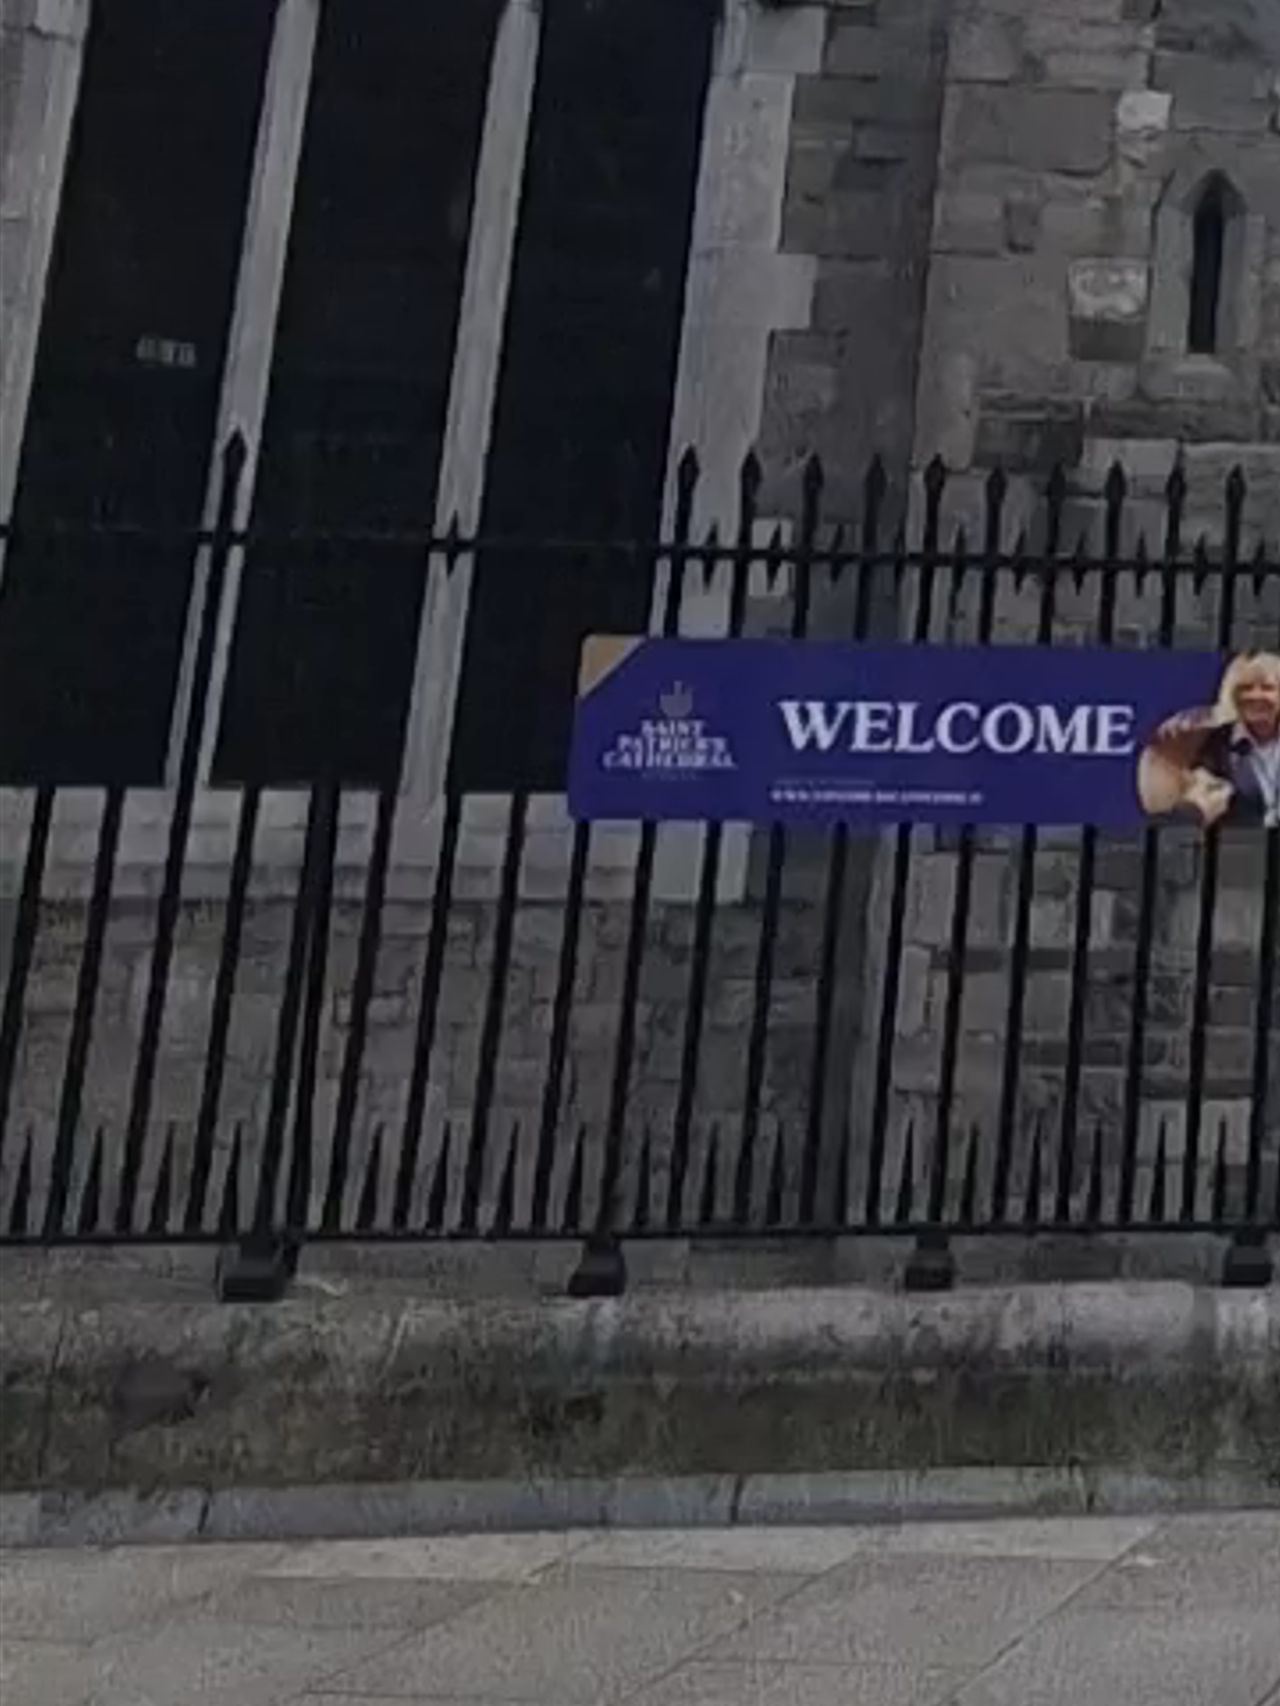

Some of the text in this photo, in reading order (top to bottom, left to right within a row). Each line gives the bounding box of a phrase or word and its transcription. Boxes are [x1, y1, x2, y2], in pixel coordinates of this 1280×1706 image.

[641, 719, 704, 735] SAINT
[778, 701, 1135, 754] WELCOME
[602, 751, 736, 769] CATHEDRAL
